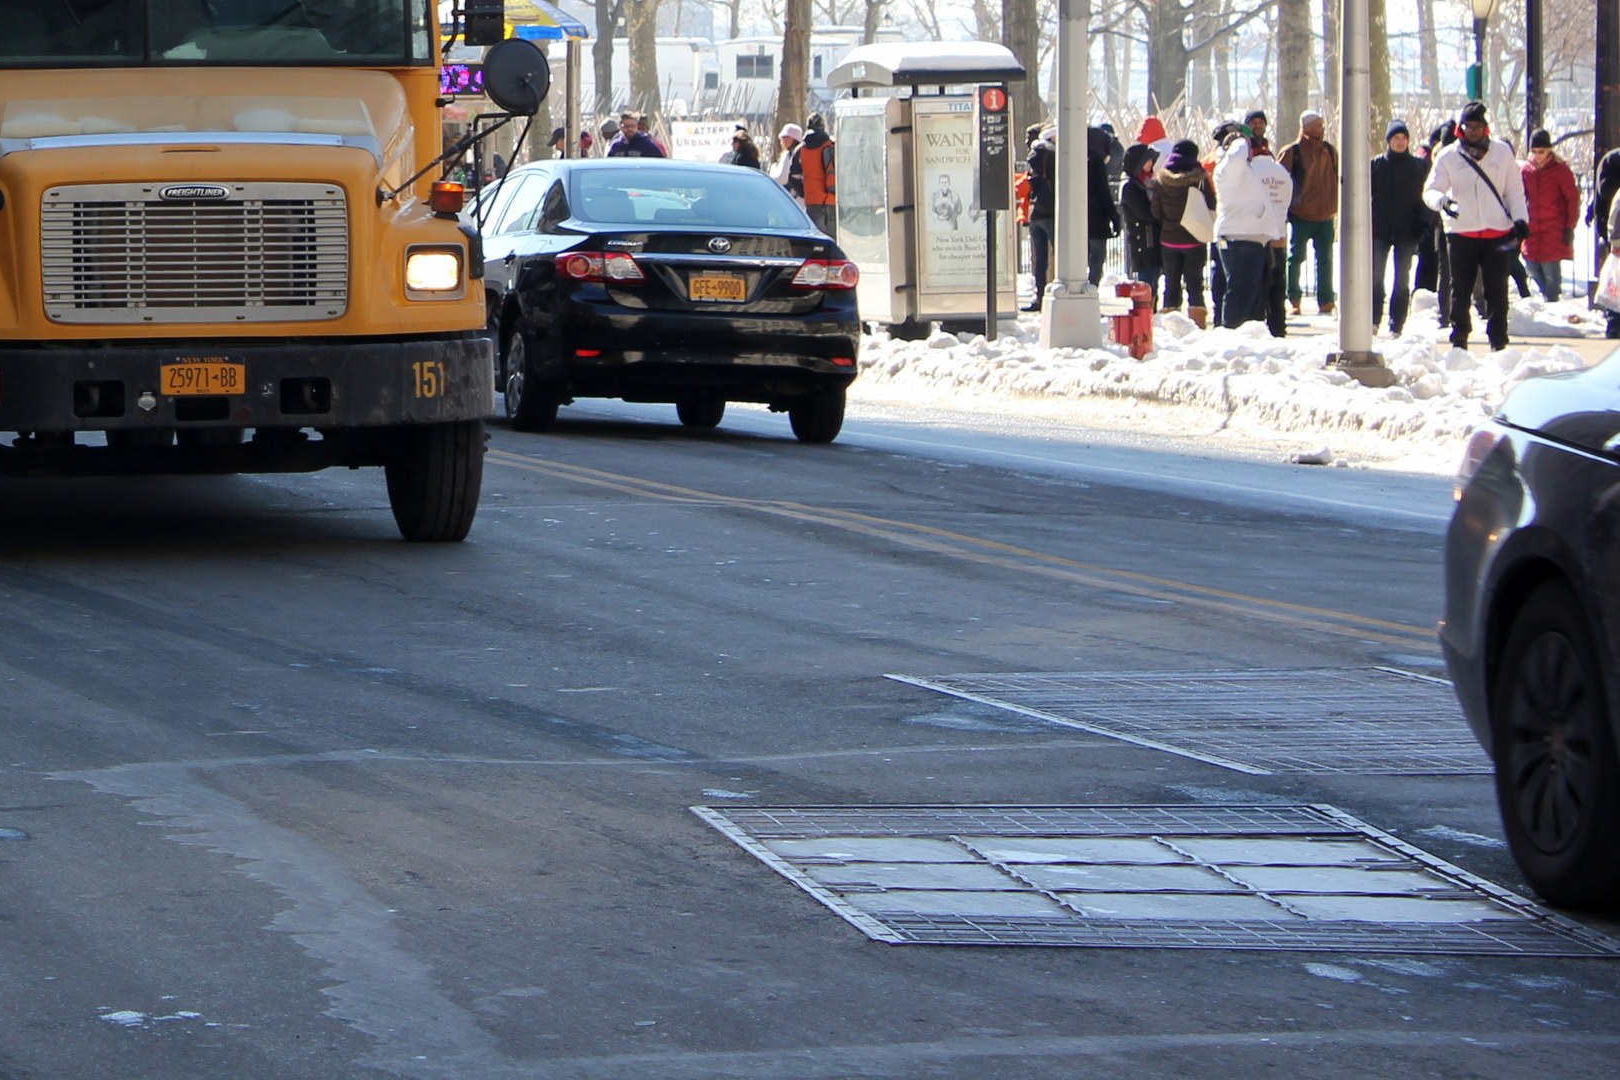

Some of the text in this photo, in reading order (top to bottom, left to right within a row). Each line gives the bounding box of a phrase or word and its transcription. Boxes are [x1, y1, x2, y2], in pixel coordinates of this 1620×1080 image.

[948, 103, 973, 111] TITA
[166, 188, 224, 197] FREIGHTLINER
[169, 367, 237, 388] 25971 BB
[412, 361, 445, 398] 151
